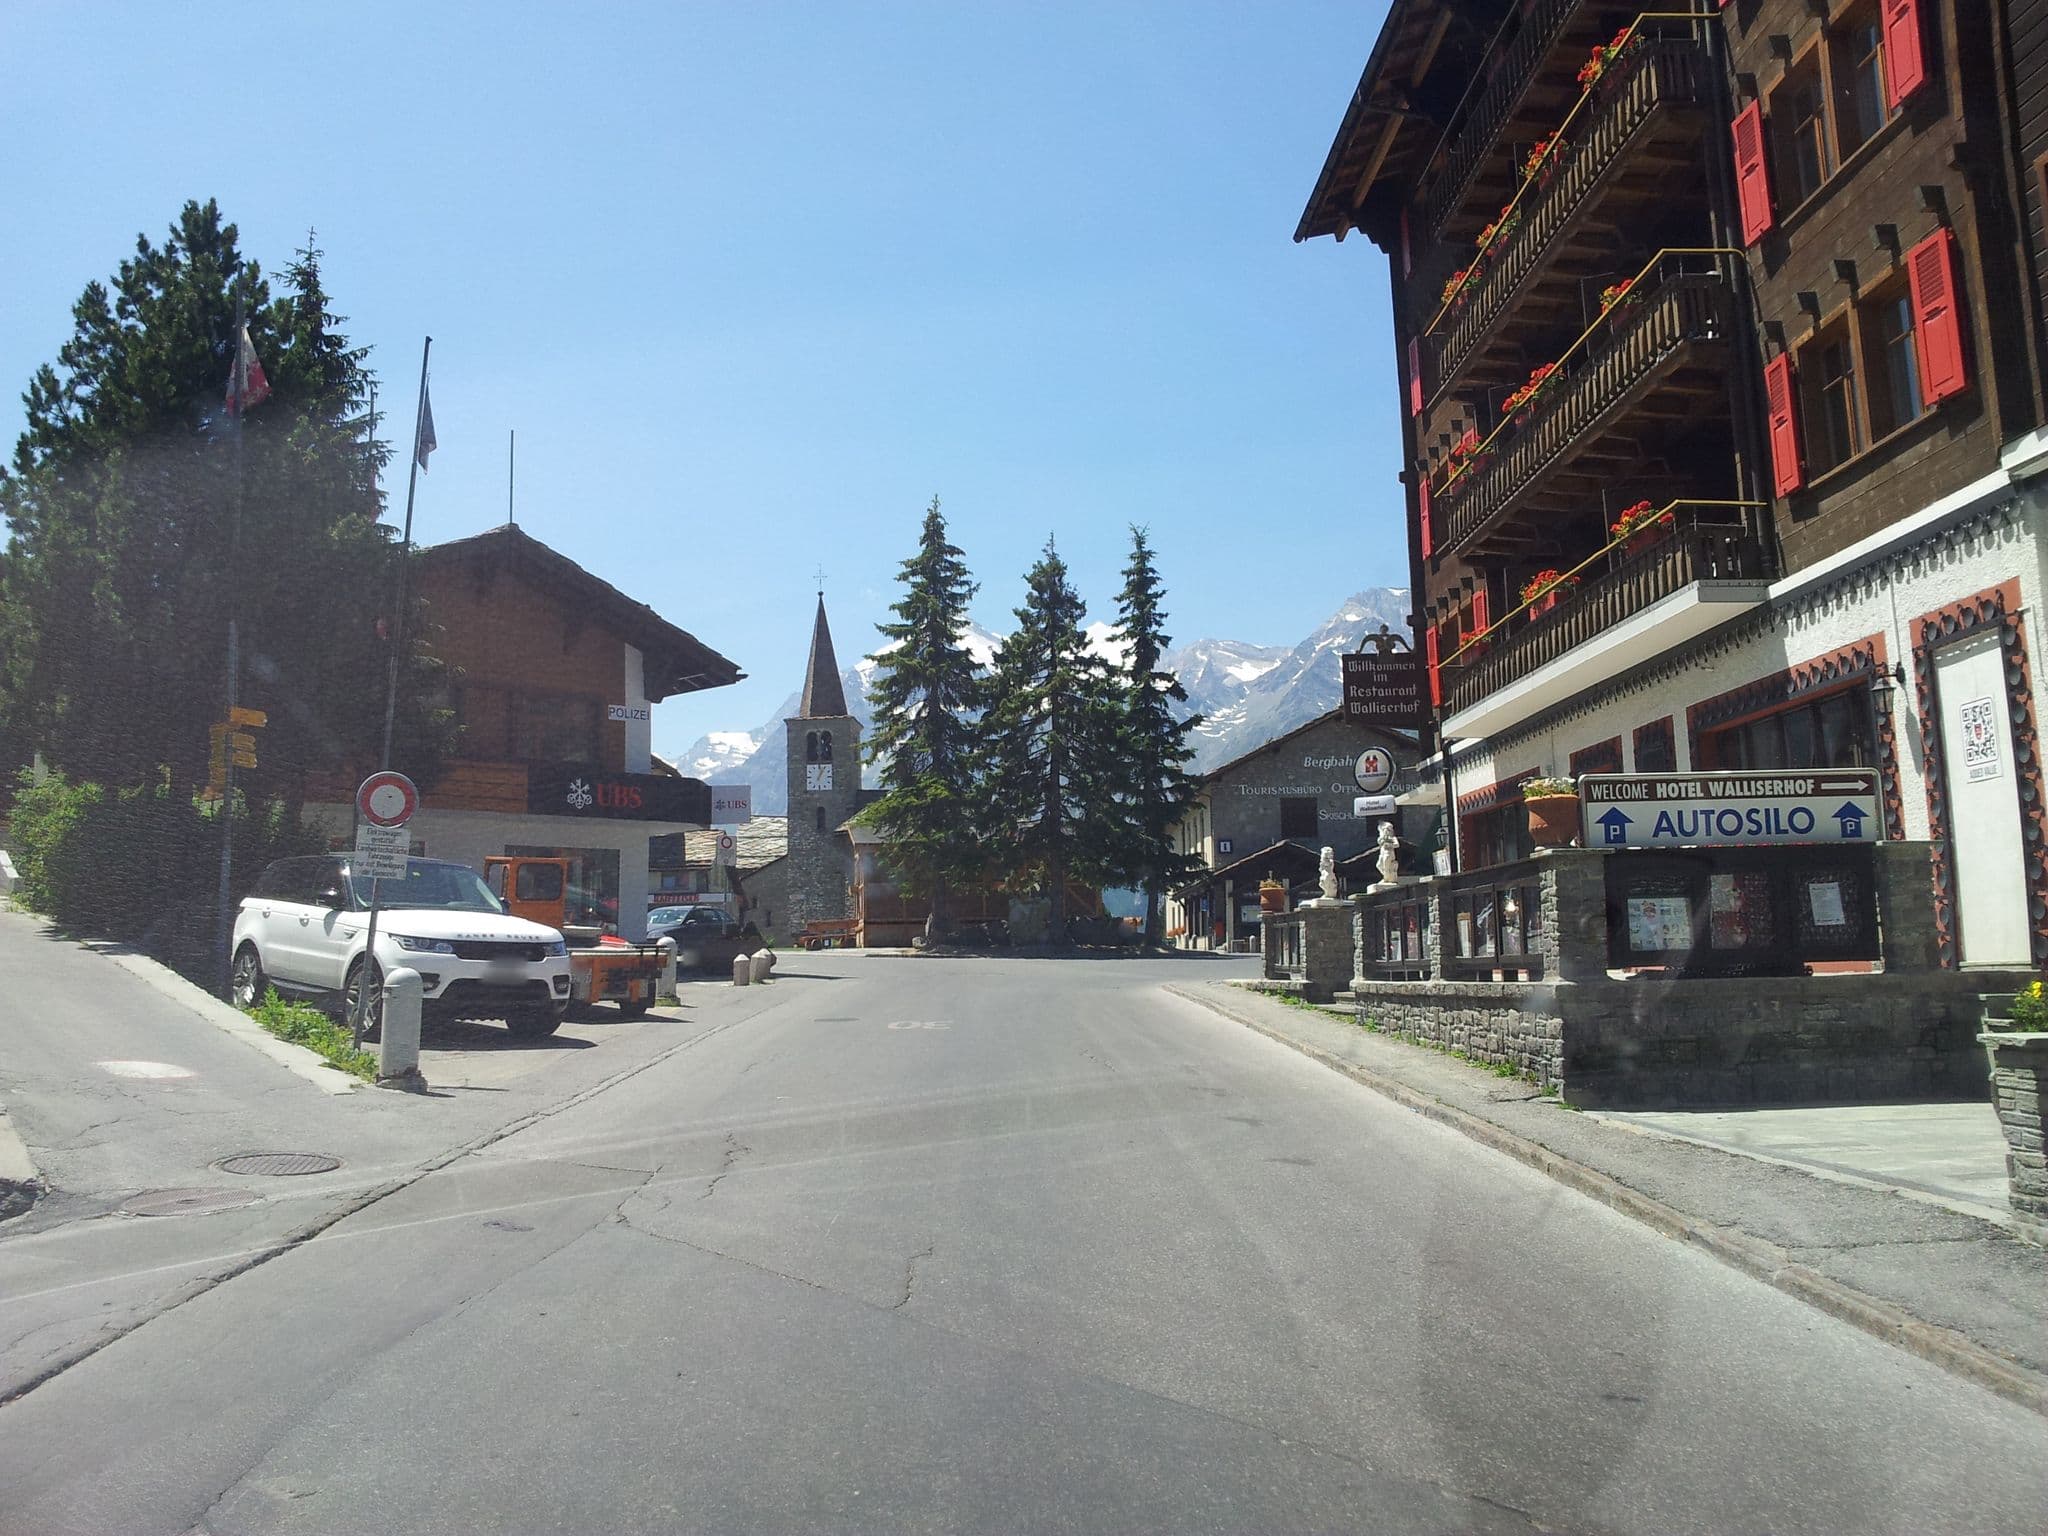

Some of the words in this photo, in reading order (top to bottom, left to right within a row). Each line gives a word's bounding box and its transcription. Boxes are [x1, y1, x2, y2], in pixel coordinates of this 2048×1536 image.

[1348, 660, 1416, 672] Willkommen
[1373, 672, 1388, 682] im
[1350, 684, 1417, 697] Restaurant
[609, 706, 649, 721] POLIZEI
[1350, 700, 1420, 714] Walliserhof
[1304, 756, 1356, 769] Bergbah
[1331, 783, 1363, 793] OFFIC
[1590, 783, 1649, 800] WELCOME
[1656, 781, 1704, 798] HOTEL
[1708, 779, 1815, 798] WALLISERHOF
[597, 783, 642, 808] UBS
[727, 800, 747, 809] UBS
[1609, 825, 1620, 840] P
[1652, 806, 1815, 838] AUTOSILO
[1846, 822, 1856, 835] P
